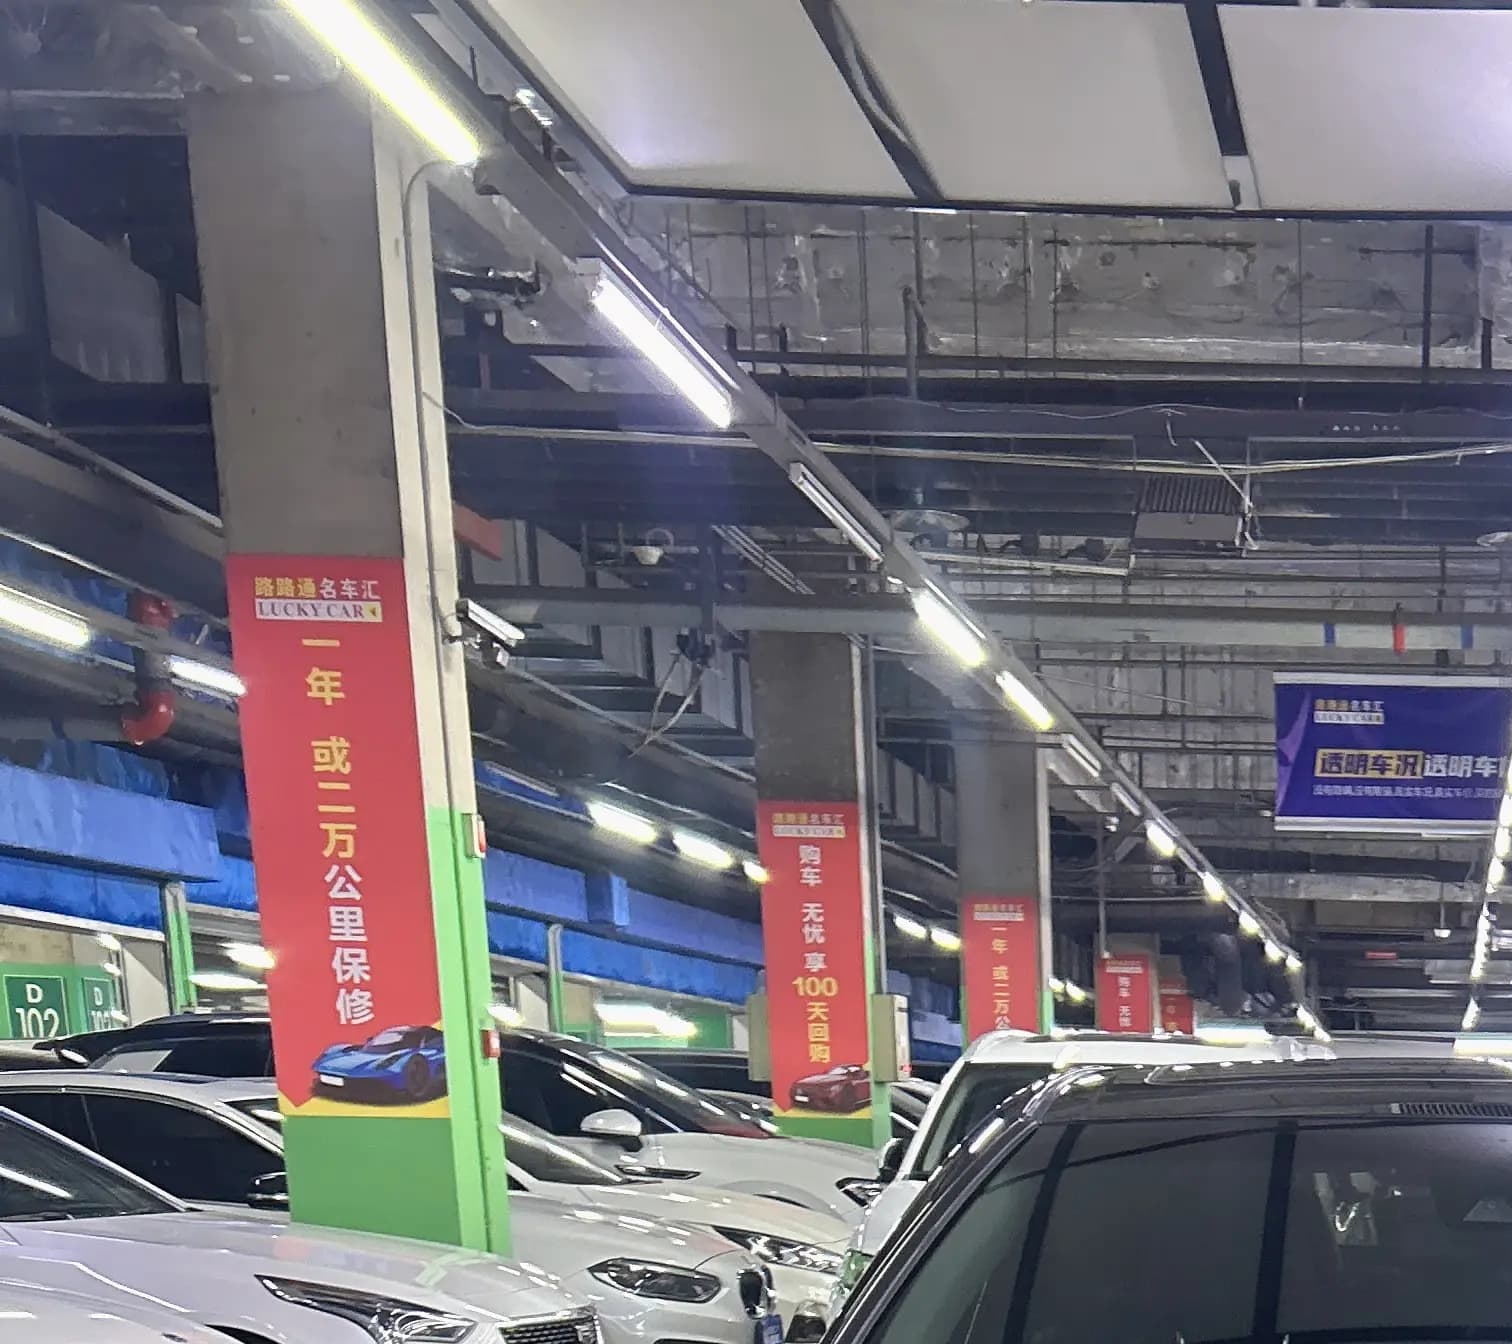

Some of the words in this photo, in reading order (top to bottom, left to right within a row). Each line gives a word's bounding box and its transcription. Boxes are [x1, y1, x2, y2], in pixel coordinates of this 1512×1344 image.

[255, 576, 381, 599] 路路通名车汇
[257, 601, 322, 617] LUCKY
[326, 603, 365, 618] CAR
[25, 984, 43, 1003] D
[15, 1007, 60, 1038] 102
